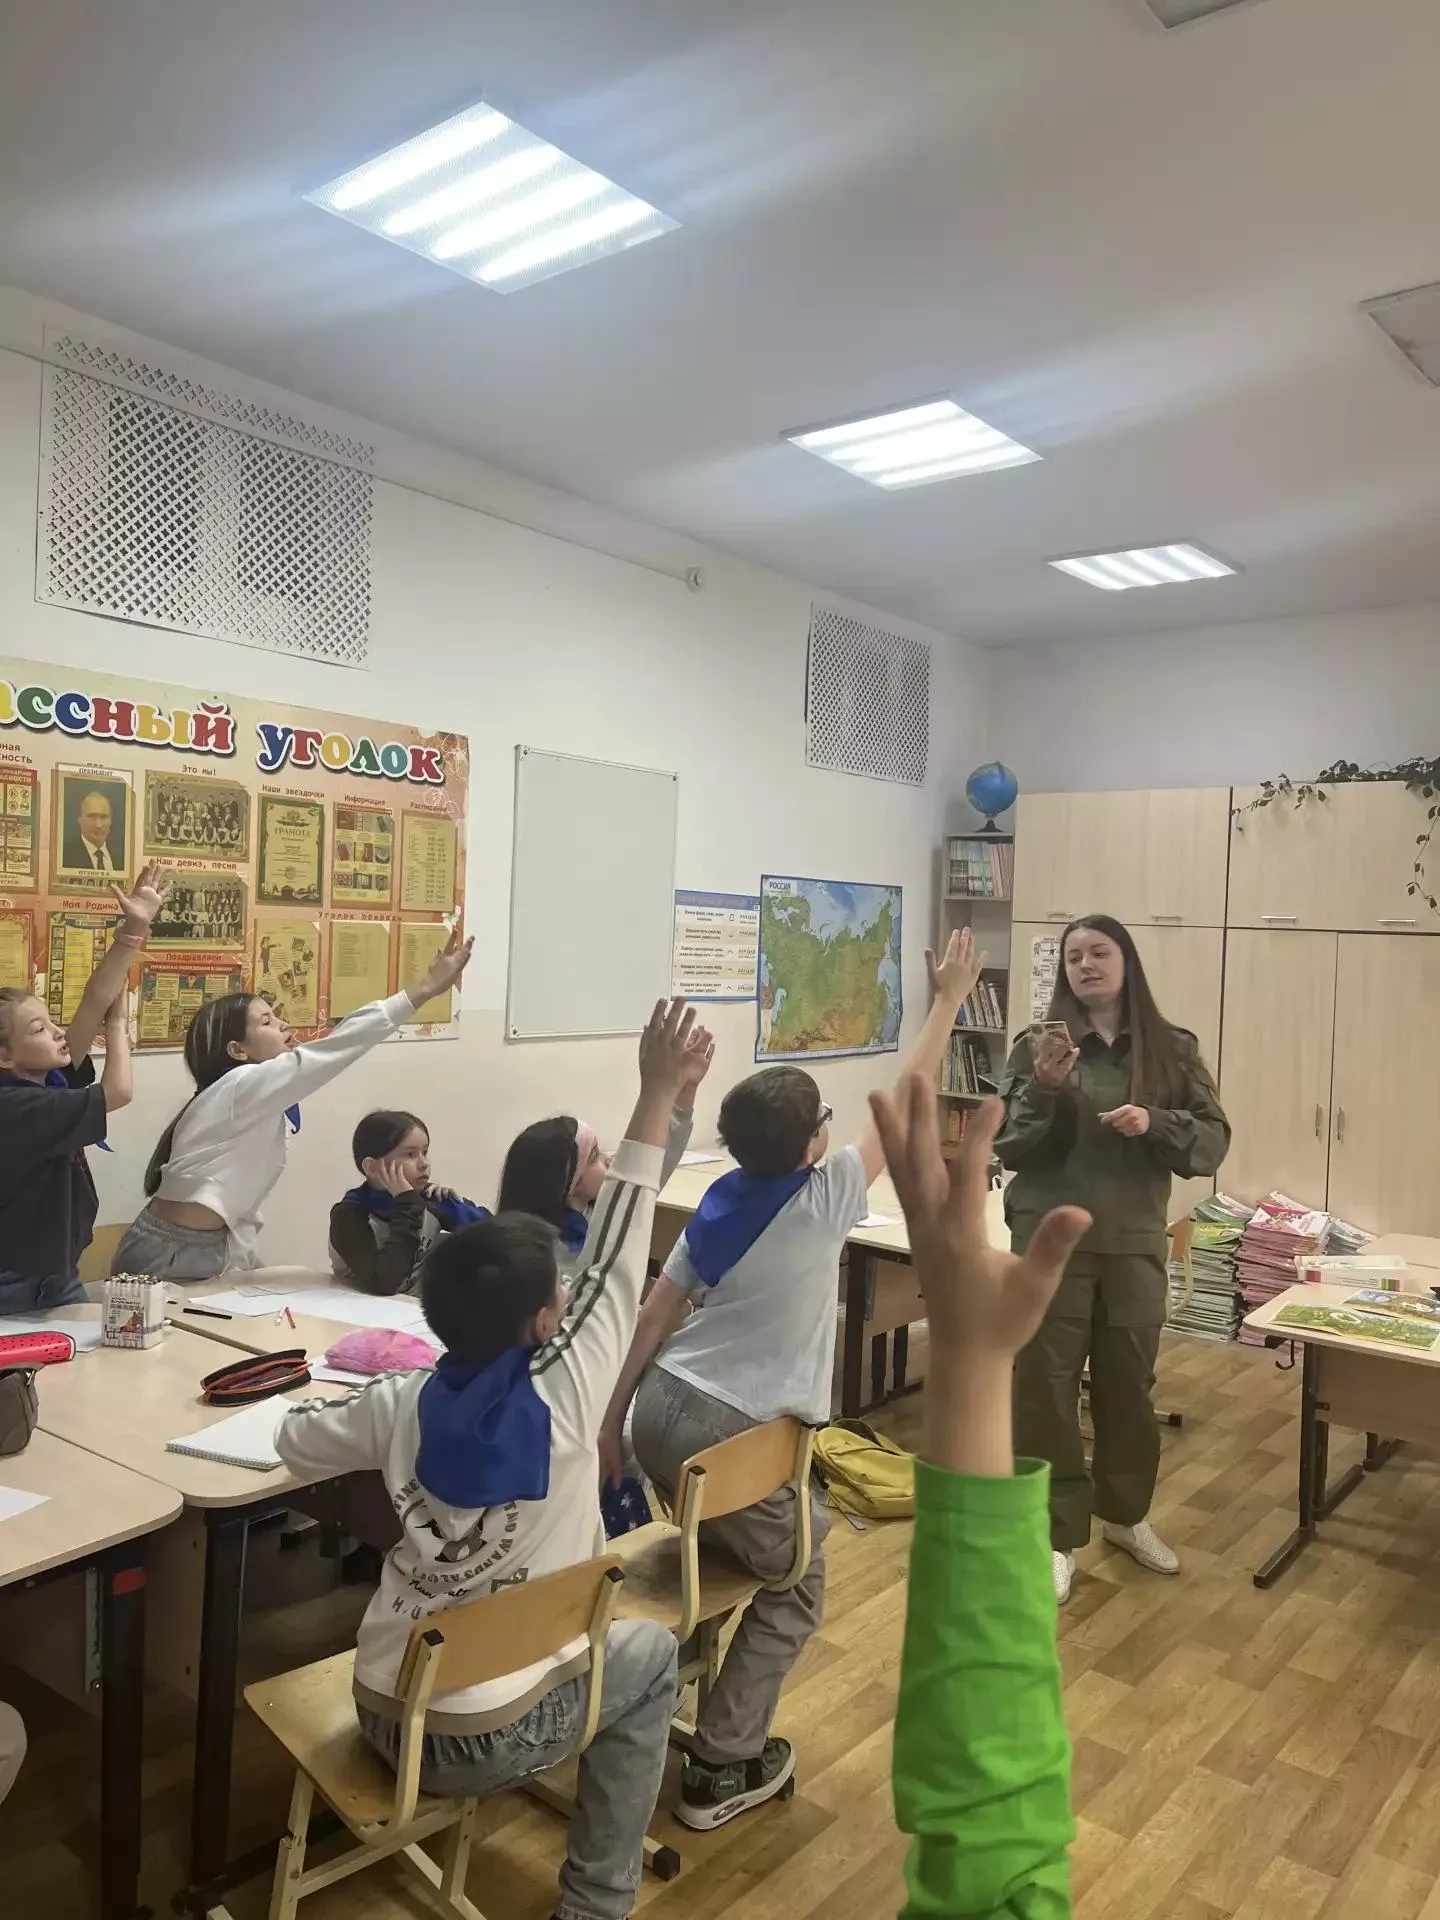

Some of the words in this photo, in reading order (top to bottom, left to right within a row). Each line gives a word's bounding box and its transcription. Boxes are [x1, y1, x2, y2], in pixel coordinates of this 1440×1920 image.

[0, 743, 21, 752] ная
[0, 754, 33, 764] ность
[182, 765, 198, 774] Это
[202, 768, 216, 776] мы!
[262, 784, 281, 793] Наши
[285, 788, 325, 798] звездочки
[274, 827, 311, 837] ГРАМОТА
[156, 857, 172, 866] Наш
[177, 860, 206, 869] девиз,
[212, 862, 237, 870] песня
[769, 881, 791, 889] РОССИЯ
[62, 900, 80, 909] Моя
[86, 901, 119, 911] Родина
[318, 911, 354, 920] Уголок
[166, 953, 222, 962] Поздравляем
